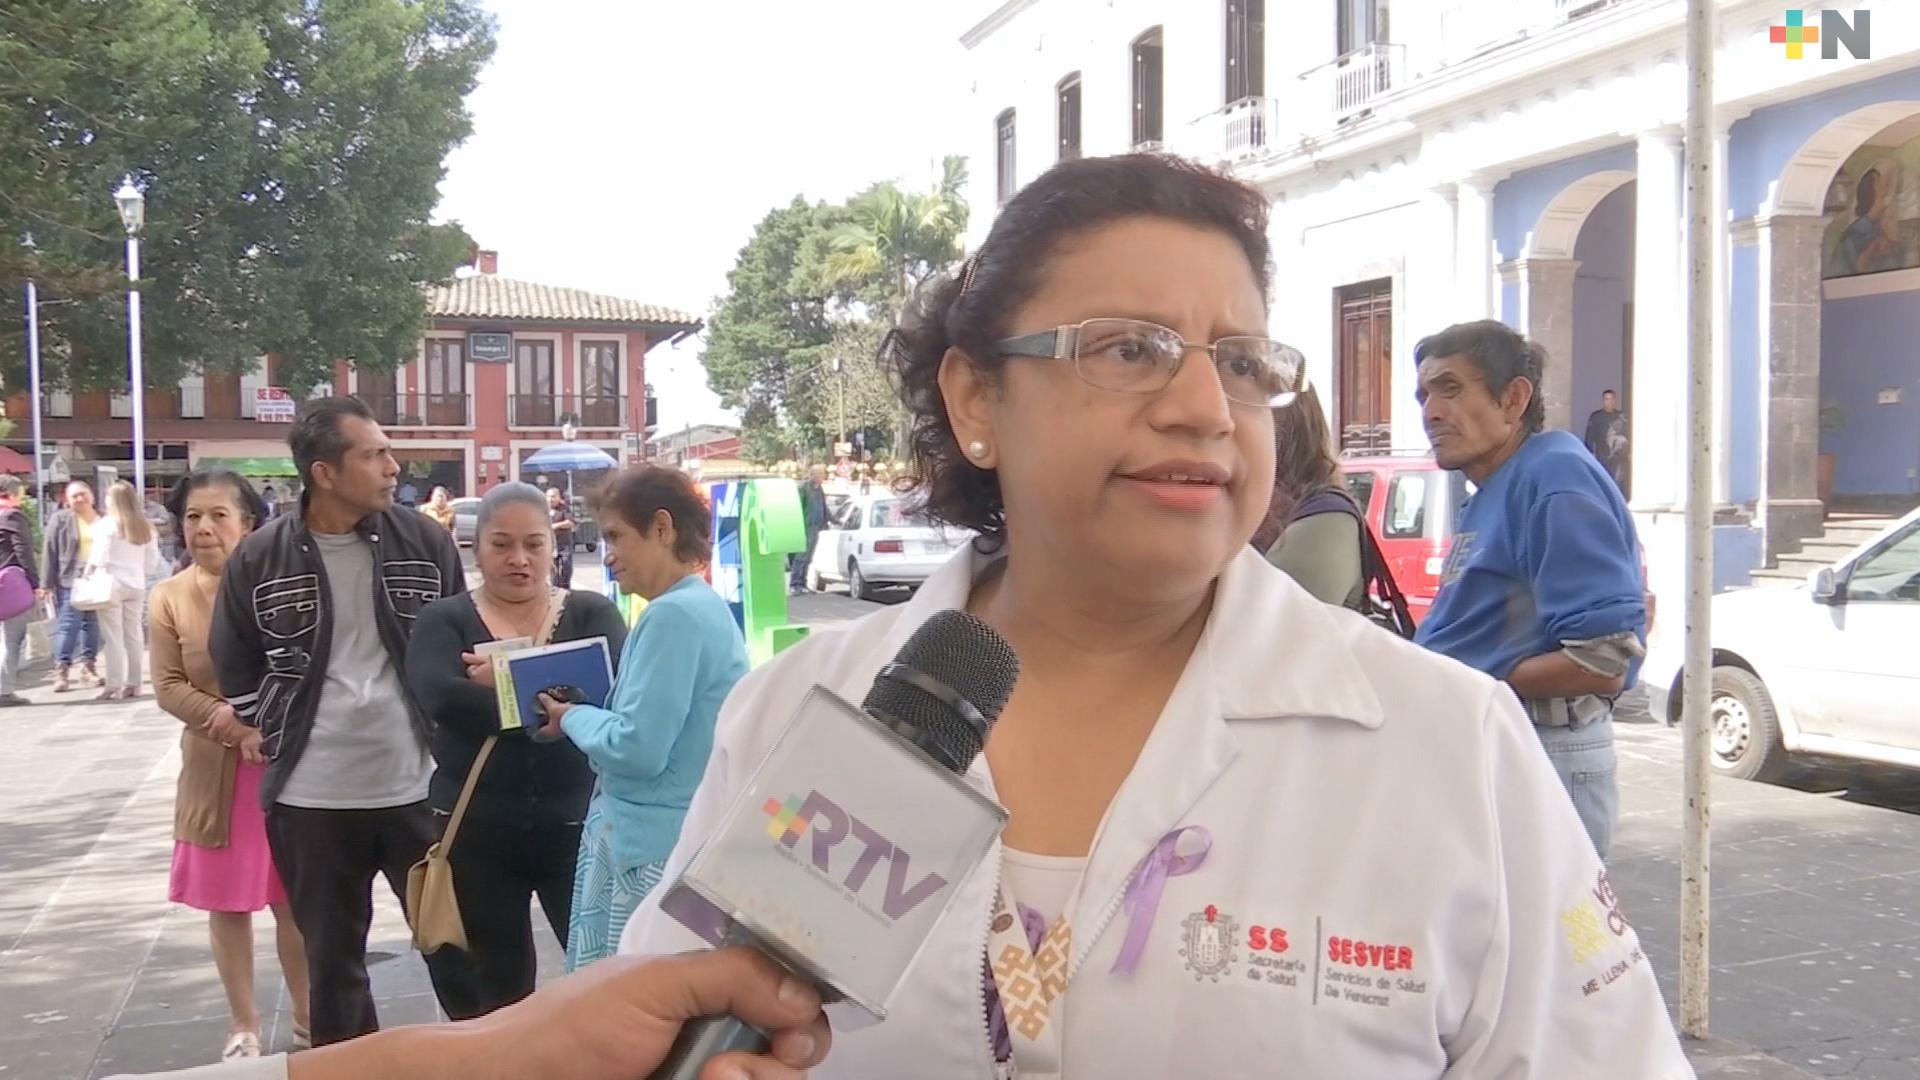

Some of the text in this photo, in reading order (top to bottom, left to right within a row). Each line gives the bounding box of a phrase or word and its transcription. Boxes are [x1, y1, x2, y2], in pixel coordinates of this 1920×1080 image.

[779, 789, 948, 920] RTV
[1248, 925, 1289, 953] SS
[1328, 936, 1413, 970] SESVER
[1376, 977, 1391, 990] de
